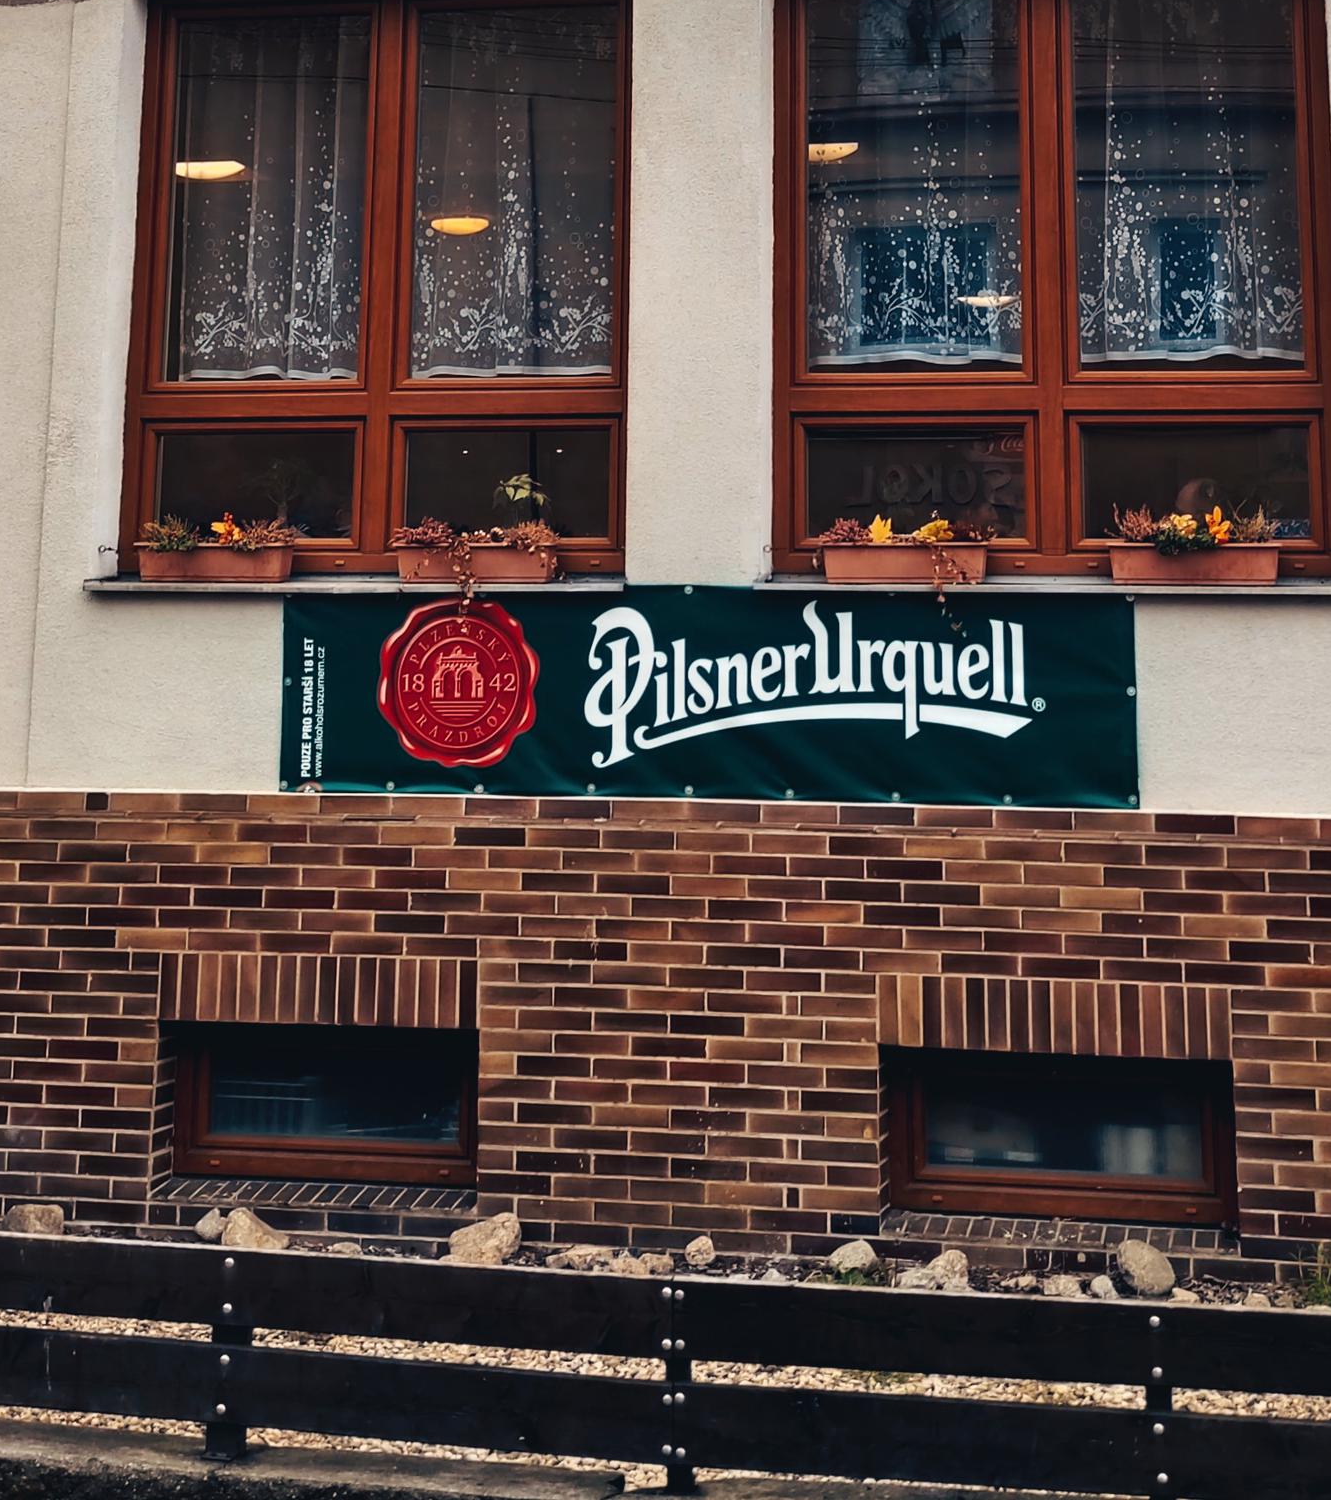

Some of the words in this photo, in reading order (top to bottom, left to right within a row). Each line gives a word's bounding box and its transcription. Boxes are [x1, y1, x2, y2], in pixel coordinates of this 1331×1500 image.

[304, 637, 314, 657] LET
[304, 660, 314, 673] 18
[402, 672, 425, 693] 18
[489, 672, 516, 692] 42
[583, 605, 812, 768] Pilsner
[801, 600, 1030, 740] Urquell
[301, 677, 314, 715] STARŠÍ
[314, 646, 325, 778] www.alkoholsrozumem.cz
[302, 717, 312, 740] PRO
[408, 701, 507, 743] PRAZDROJ
[301, 742, 312, 778] POUZE
